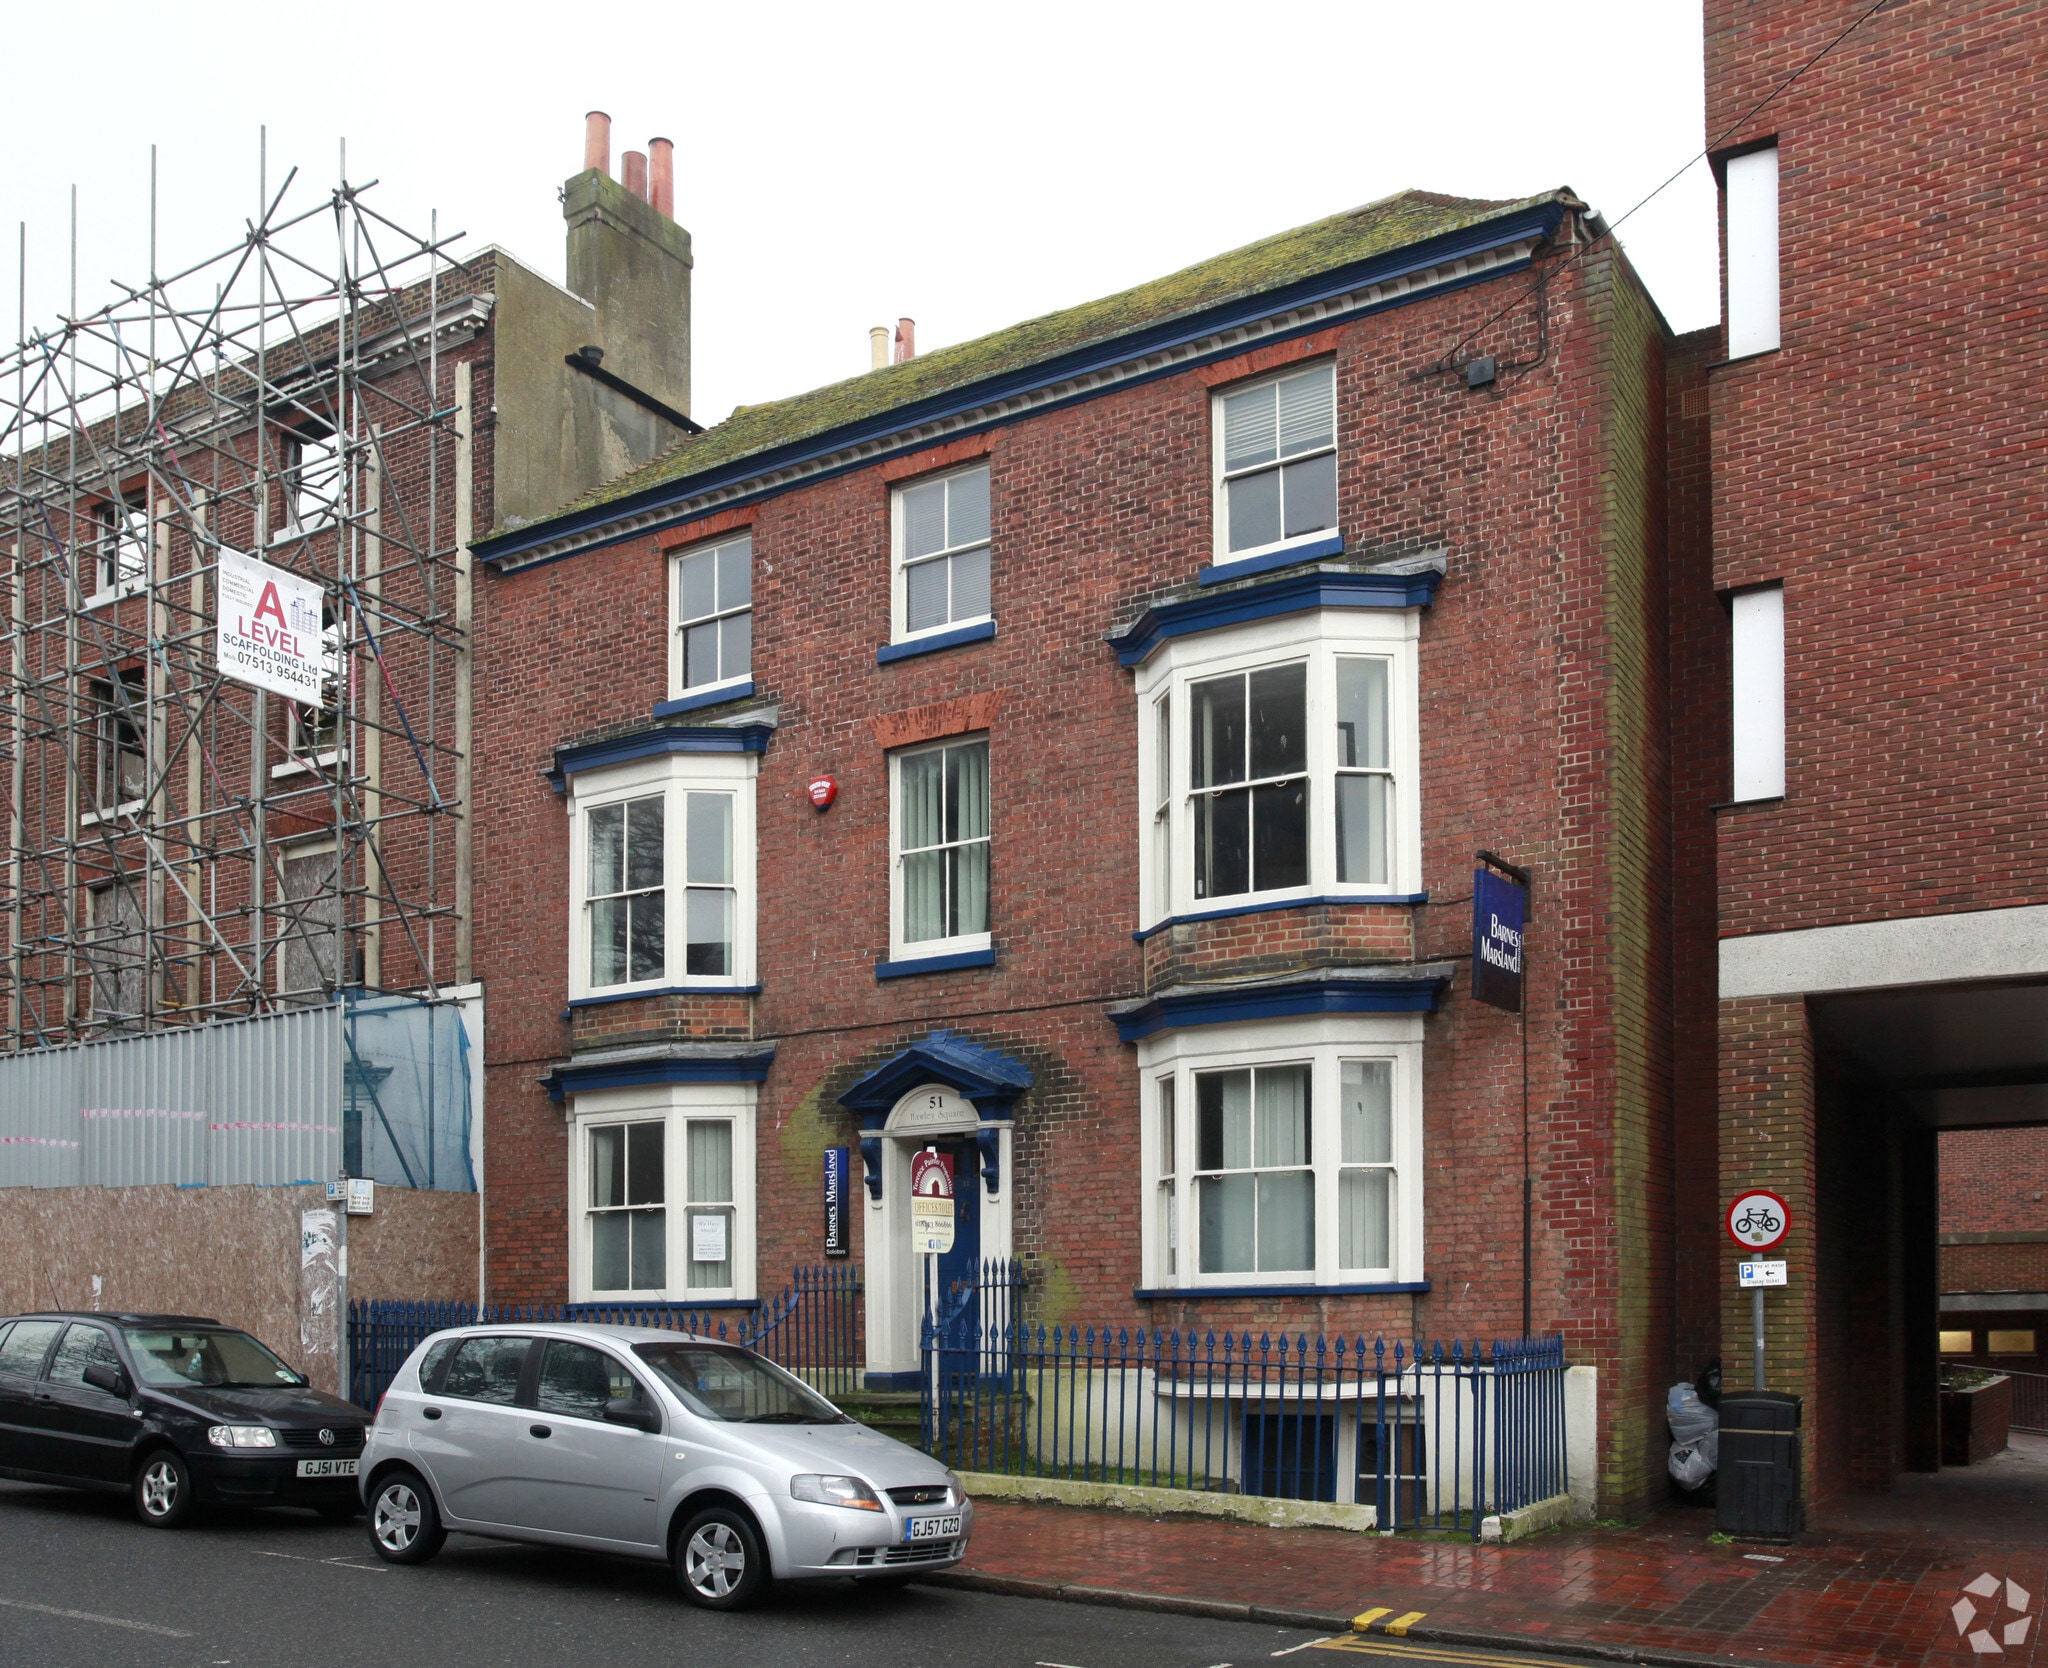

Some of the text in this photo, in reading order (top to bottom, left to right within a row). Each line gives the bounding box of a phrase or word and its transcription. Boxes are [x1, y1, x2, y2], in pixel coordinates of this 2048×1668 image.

[222, 569, 251, 586] INDUSTRIAL
[222, 577, 255, 594] COMMERCIAL
[222, 585, 248, 599] DOMESTIC
[253, 580, 288, 630] A
[238, 615, 305, 659] LEVEL
[223, 632, 318, 676] SCAFFOLDING Ltd
[237, 651, 273, 674] 07513
[276, 665, 317, 689] 954431
[929, 1095, 944, 1109] 51
[910, 1109, 965, 1121] Hawley Square
[914, 1201, 939, 1214] OFFICES
[939, 1202, 946, 1213] TO
[305, 1460, 356, 1475] GJ51 VTE
[913, 1517, 960, 1537] GJ57 GZO
